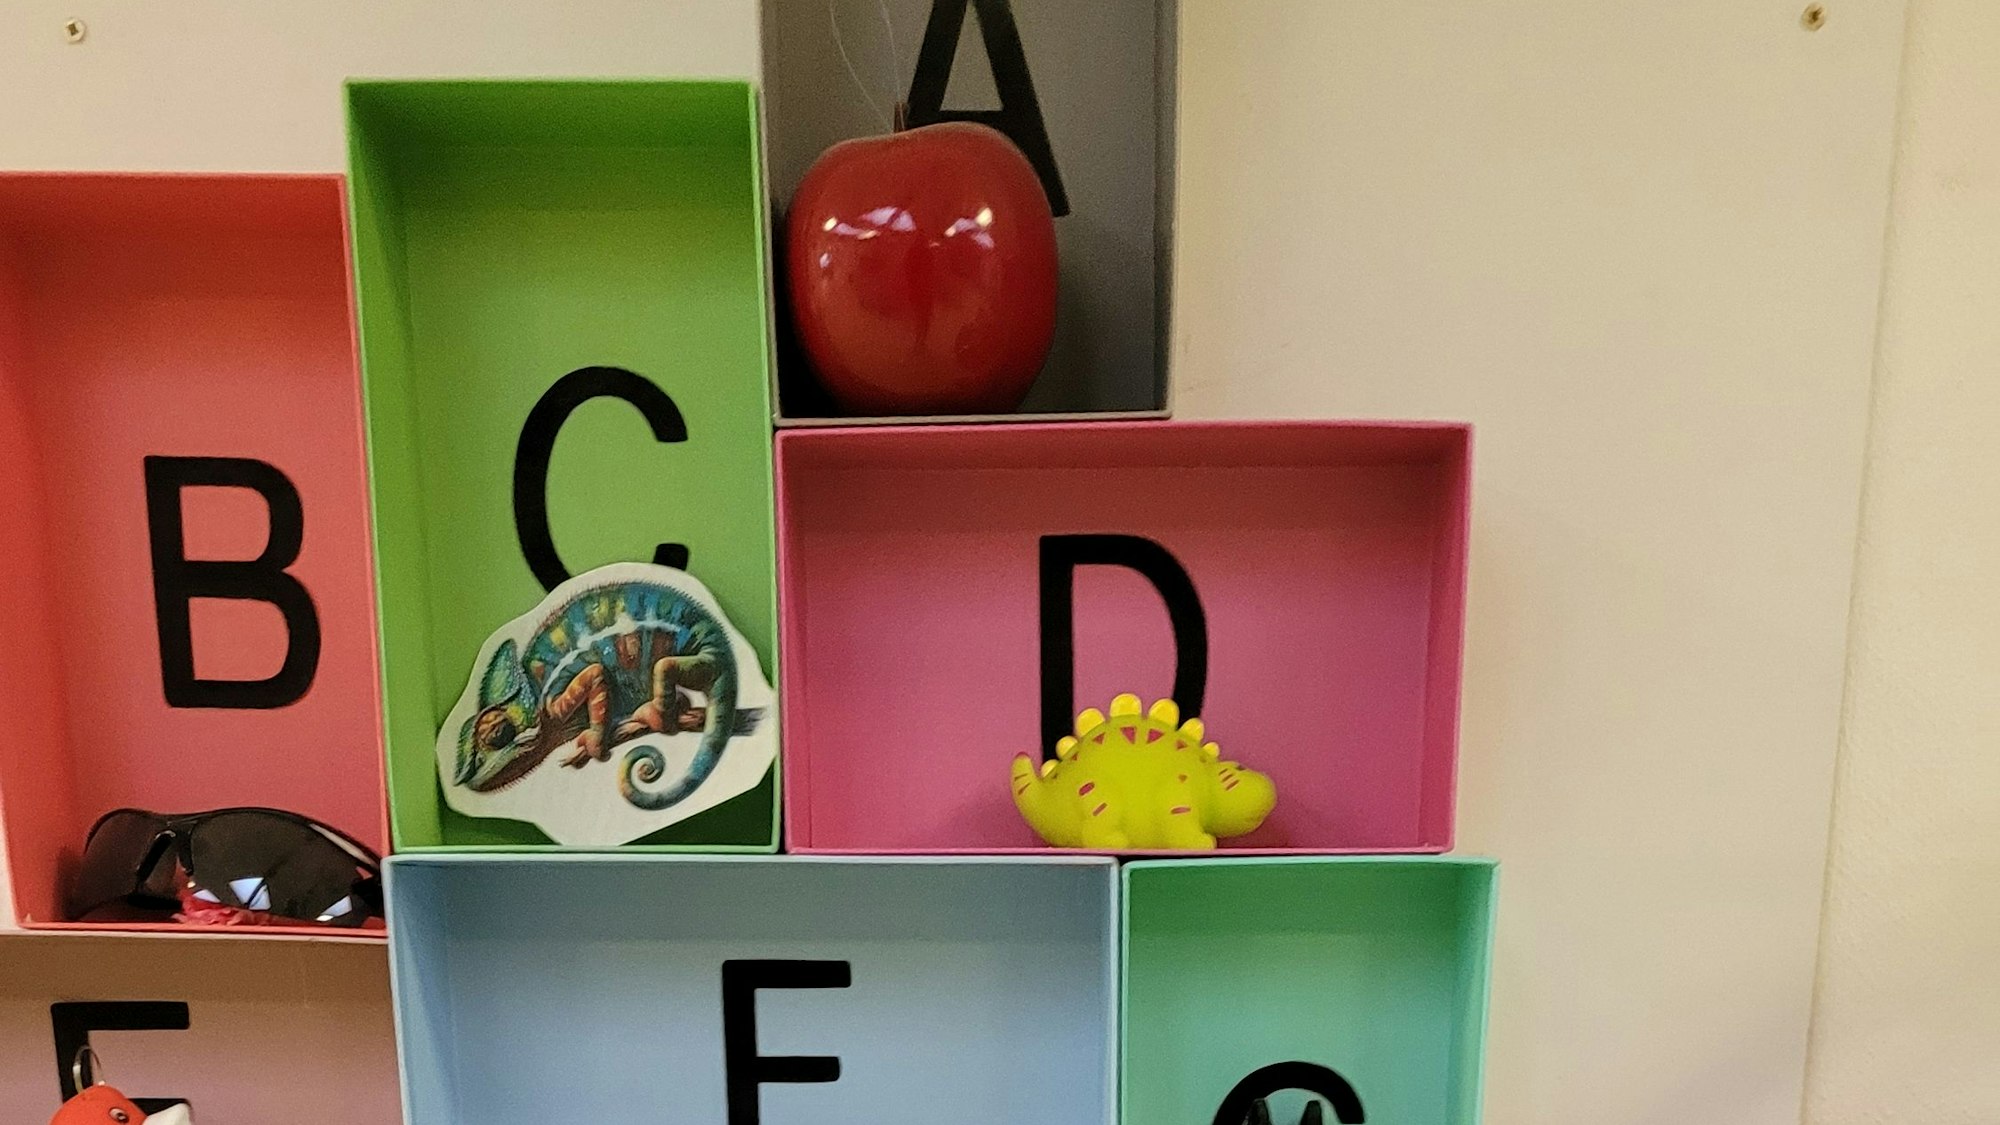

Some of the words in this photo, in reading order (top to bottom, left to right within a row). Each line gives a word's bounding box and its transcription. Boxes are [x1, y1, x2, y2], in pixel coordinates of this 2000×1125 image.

[144, 455, 321, 710] B
[512, 366, 689, 594] C
[1039, 533, 1208, 764] D
